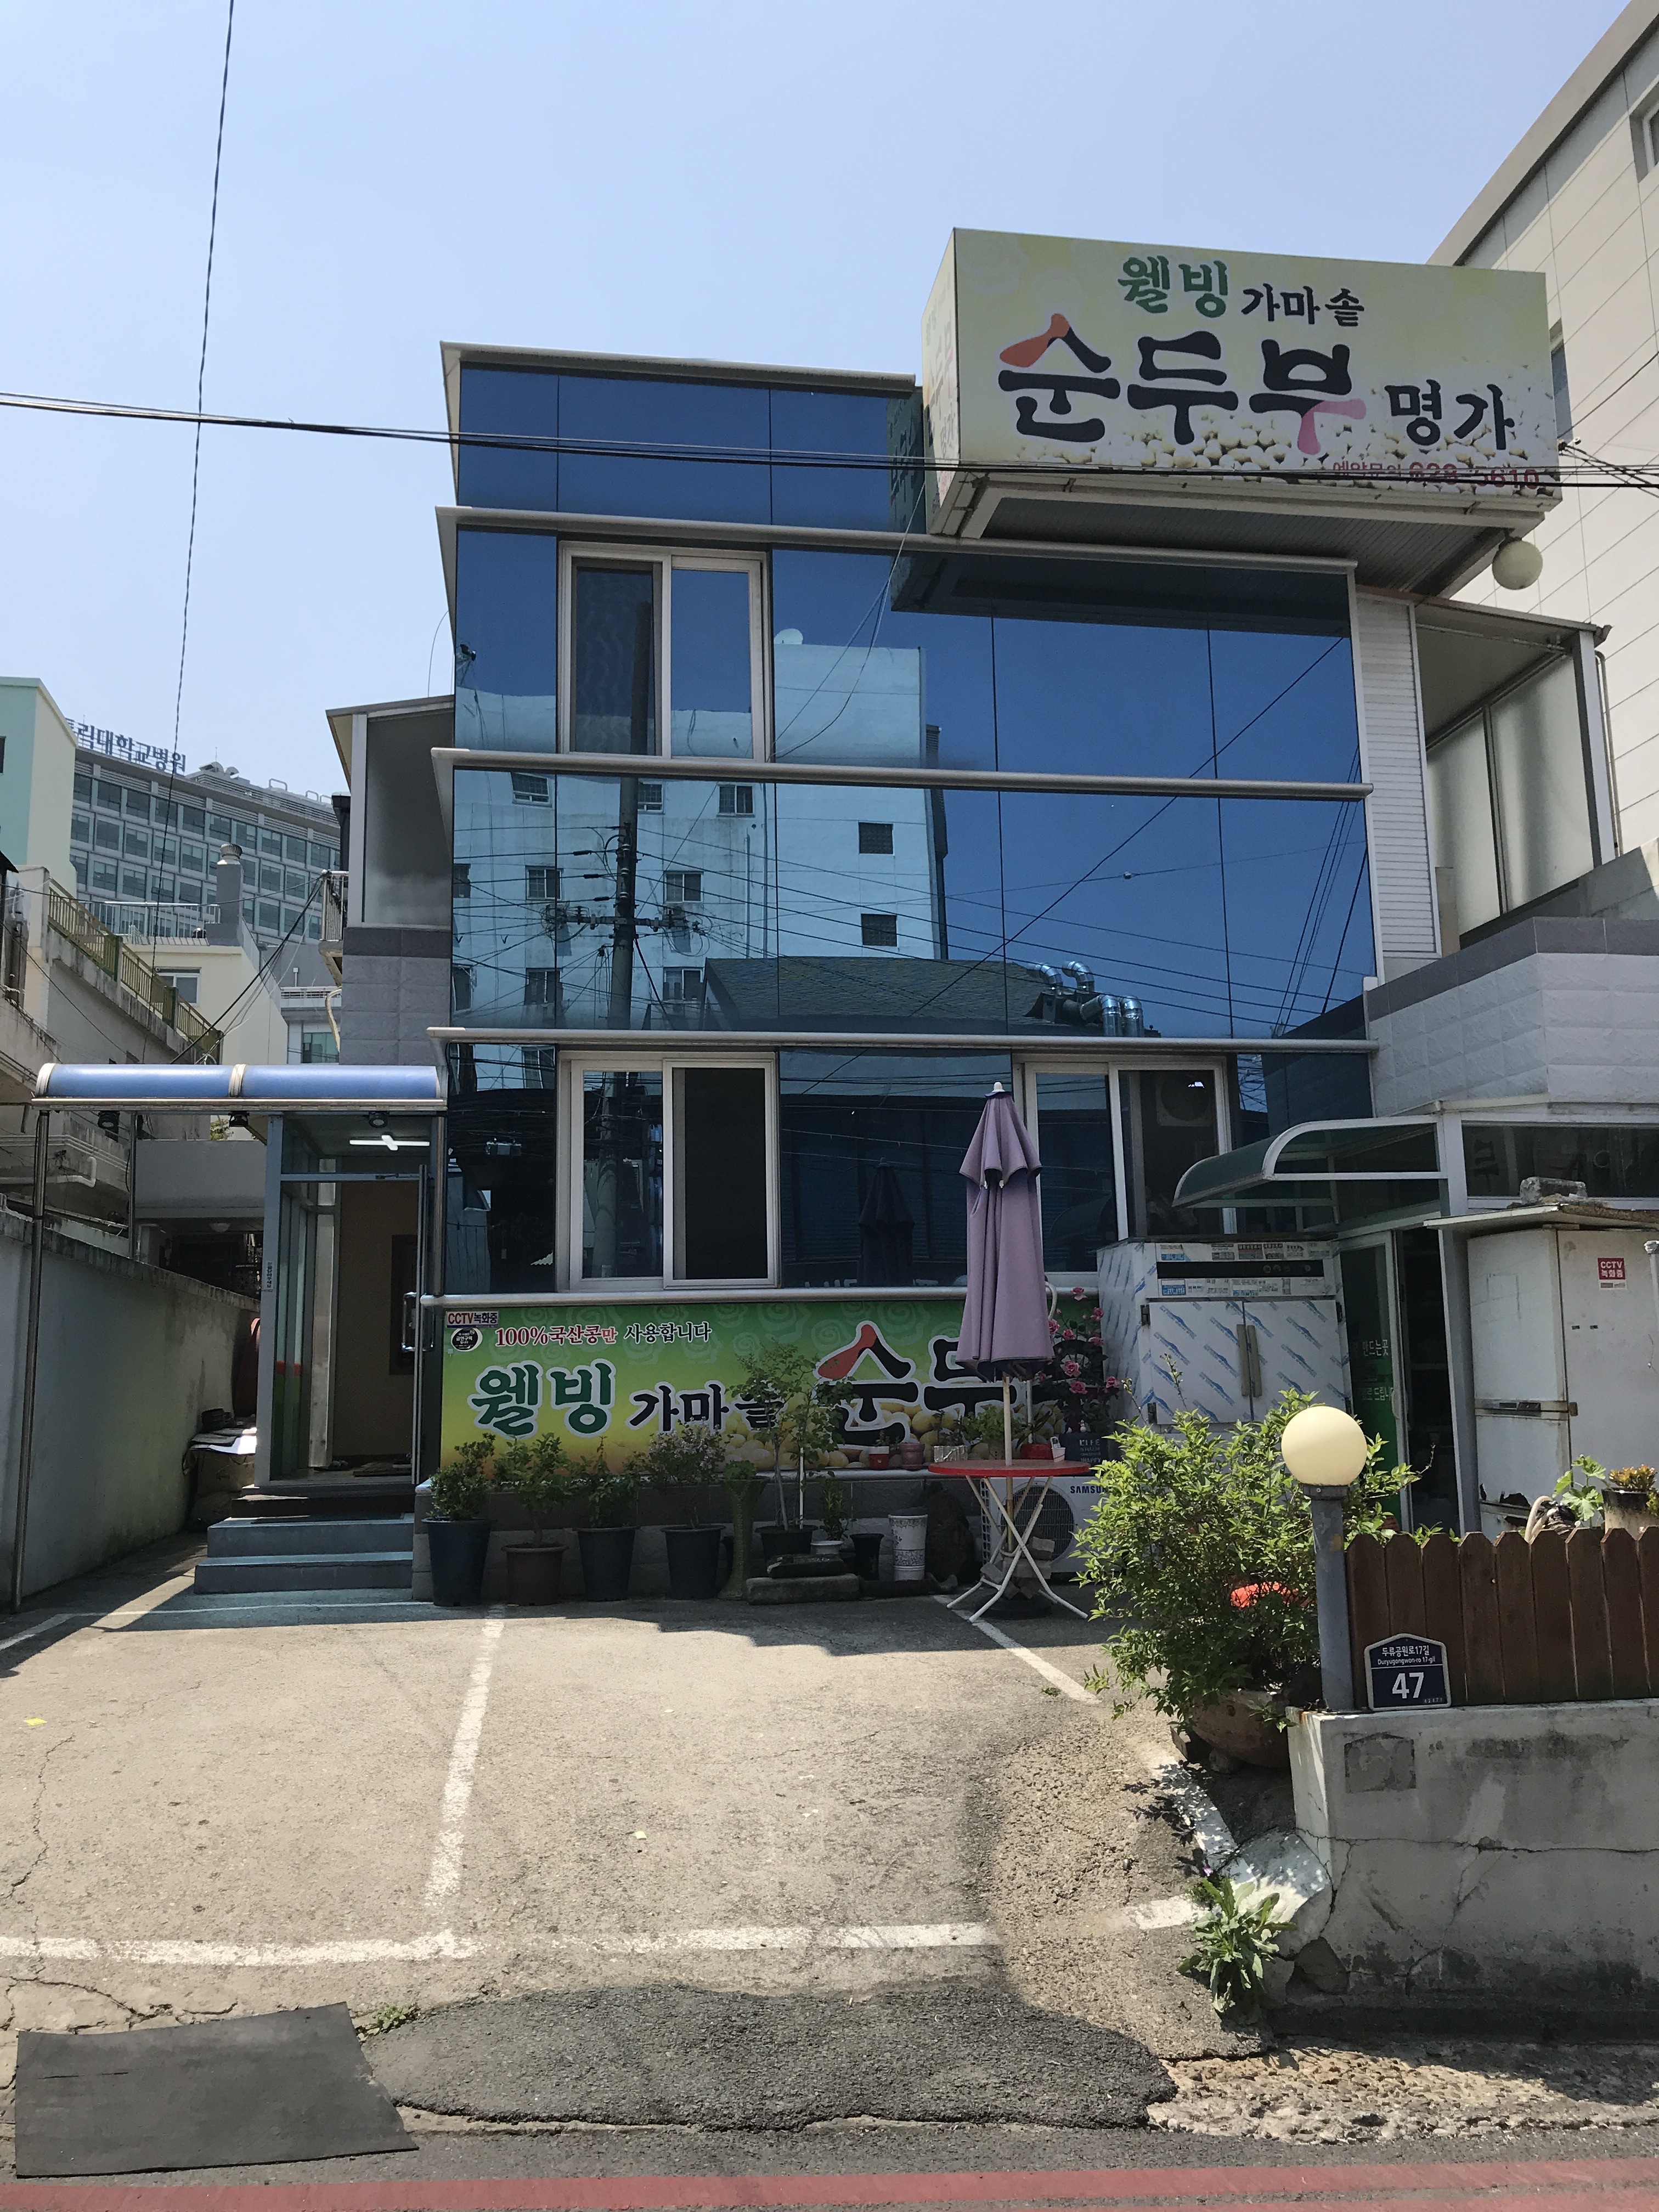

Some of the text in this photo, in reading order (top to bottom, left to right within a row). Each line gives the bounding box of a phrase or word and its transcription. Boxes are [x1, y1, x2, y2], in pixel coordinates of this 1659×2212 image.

[1117, 256, 1365, 327] 웰빙 가마솥
[998, 313, 1516, 455] 순두부 명가
[1601, 1269, 1623, 1278] 녹화중
[496, 1322, 712, 1347] 100%국산콩만 사용합니다
[472, 1363, 612, 1436] 웰빙
[1382, 1645, 1430, 1657] 두류공원로17길
[1392, 1672, 1424, 1699] 47
